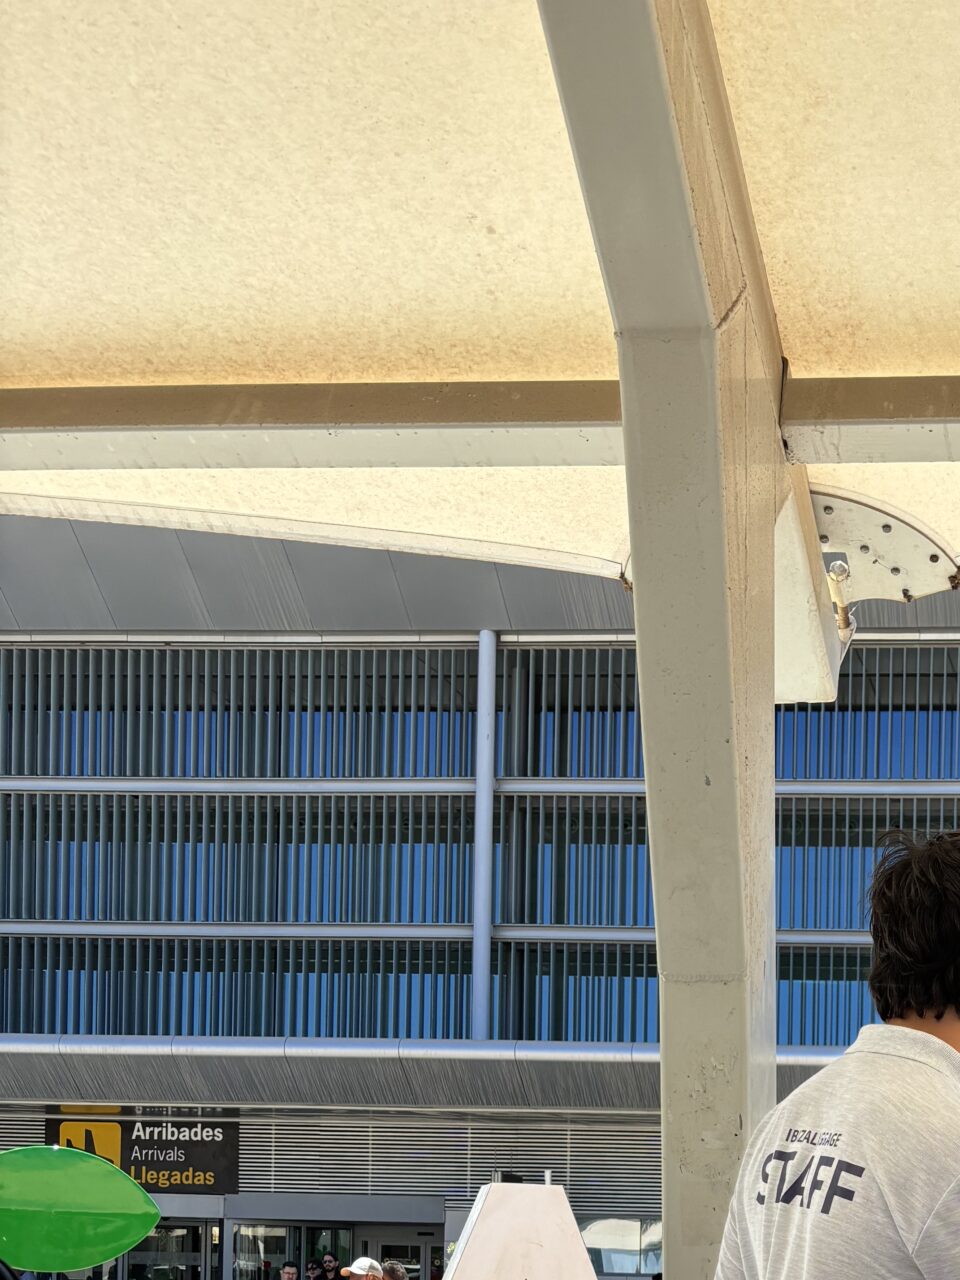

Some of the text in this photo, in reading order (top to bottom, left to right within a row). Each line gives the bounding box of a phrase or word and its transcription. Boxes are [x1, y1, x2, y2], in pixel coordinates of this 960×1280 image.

[131, 1122, 224, 1142] Arribades
[130, 1145, 186, 1162] Arrivals
[130, 1166, 215, 1188] Llegadas
[756, 1150, 866, 1215] STAFF
